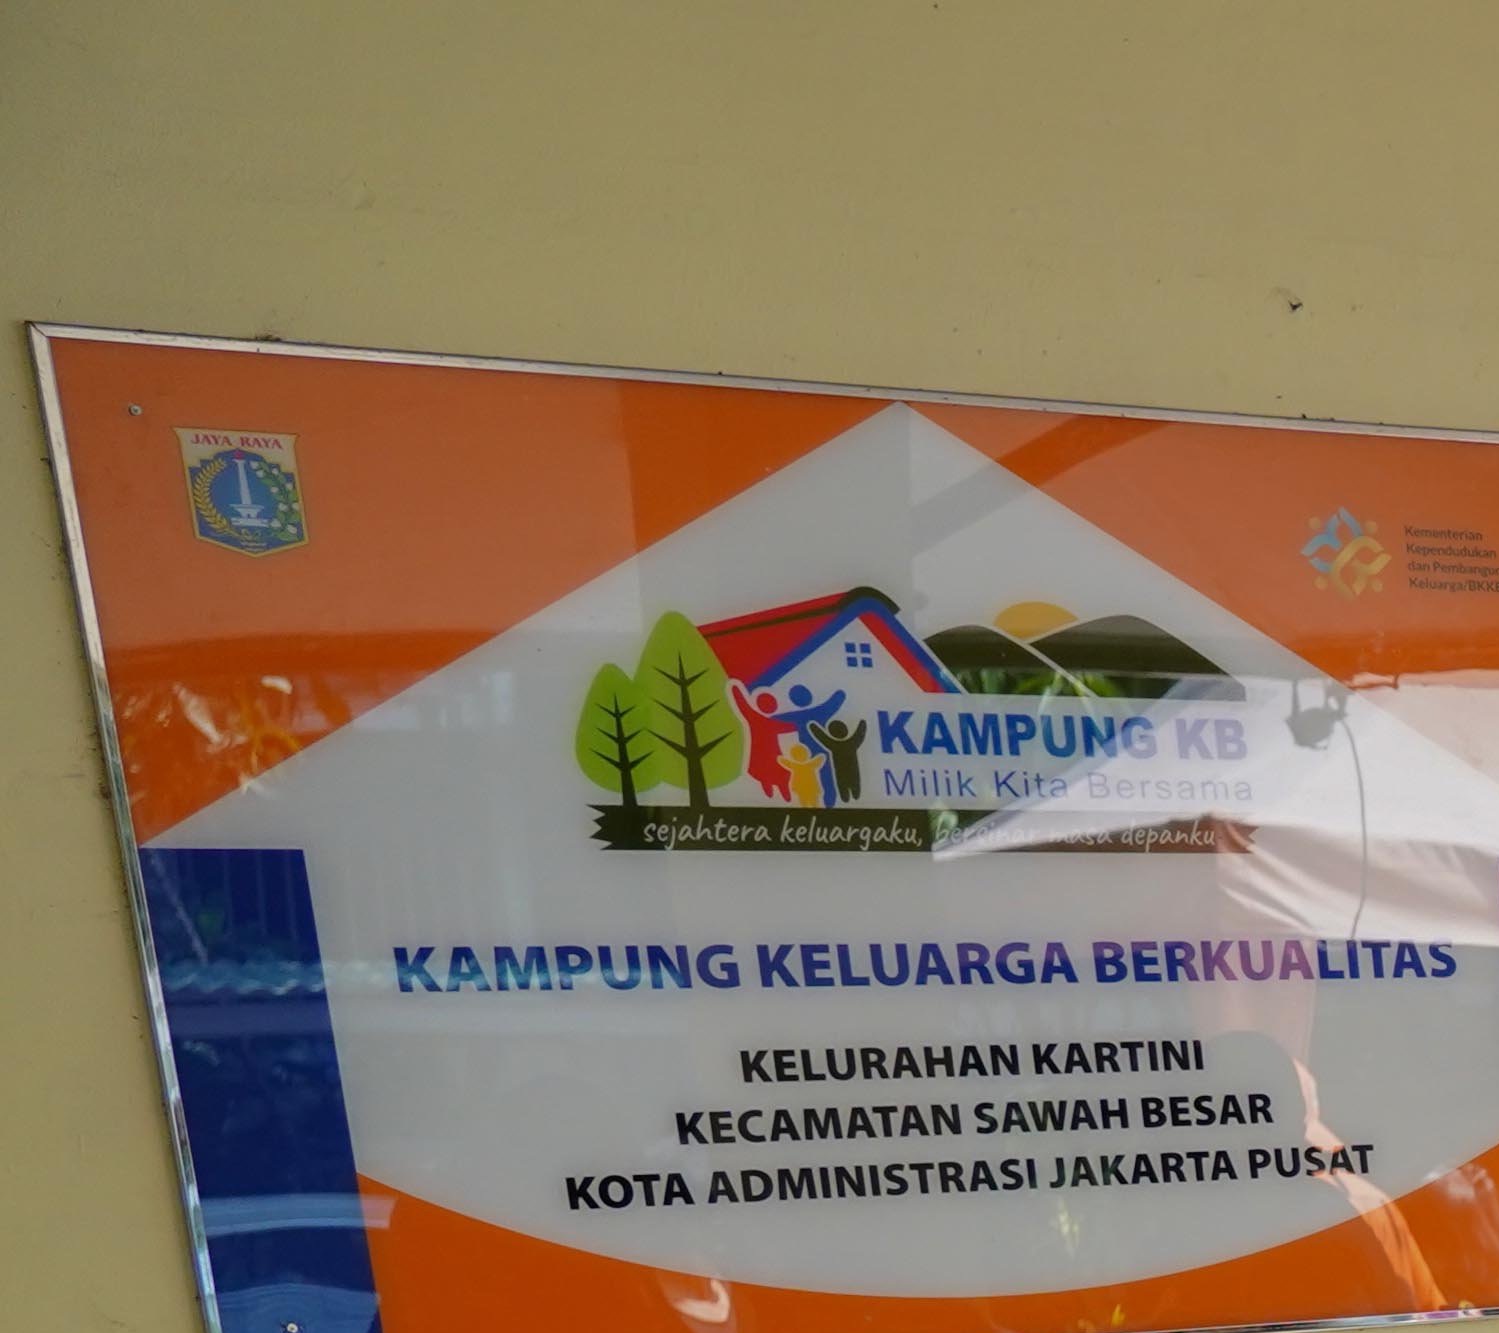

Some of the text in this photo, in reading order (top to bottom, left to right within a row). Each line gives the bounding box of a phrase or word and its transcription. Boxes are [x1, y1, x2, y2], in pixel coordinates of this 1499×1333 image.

[191, 433, 284, 450] JAYA RAYA
[1404, 525, 1483, 541] Kementerian
[1406, 543, 1497, 559] Kependudukan
[1408, 561, 1430, 572] dan
[878, 710, 1248, 762] KAMPUNG KB
[883, 768, 1254, 802] Milik Kita Bersama
[643, 815, 772, 851] sejahtera
[779, 815, 922, 851] keluargaku,
[1049, 823, 1113, 847] masa
[1120, 819, 1216, 854] depanku
[392, 937, 1459, 993] KAMPUNG KELUARGA BERKUALITAS
[738, 1038, 1205, 1083] KELURAHAN KARTINI
[675, 1092, 1274, 1145] KECAMATAN SAWAH BESAR
[565, 1143, 1375, 1211] KOTA ADMINISTRASI JAKARTA PUSAT
